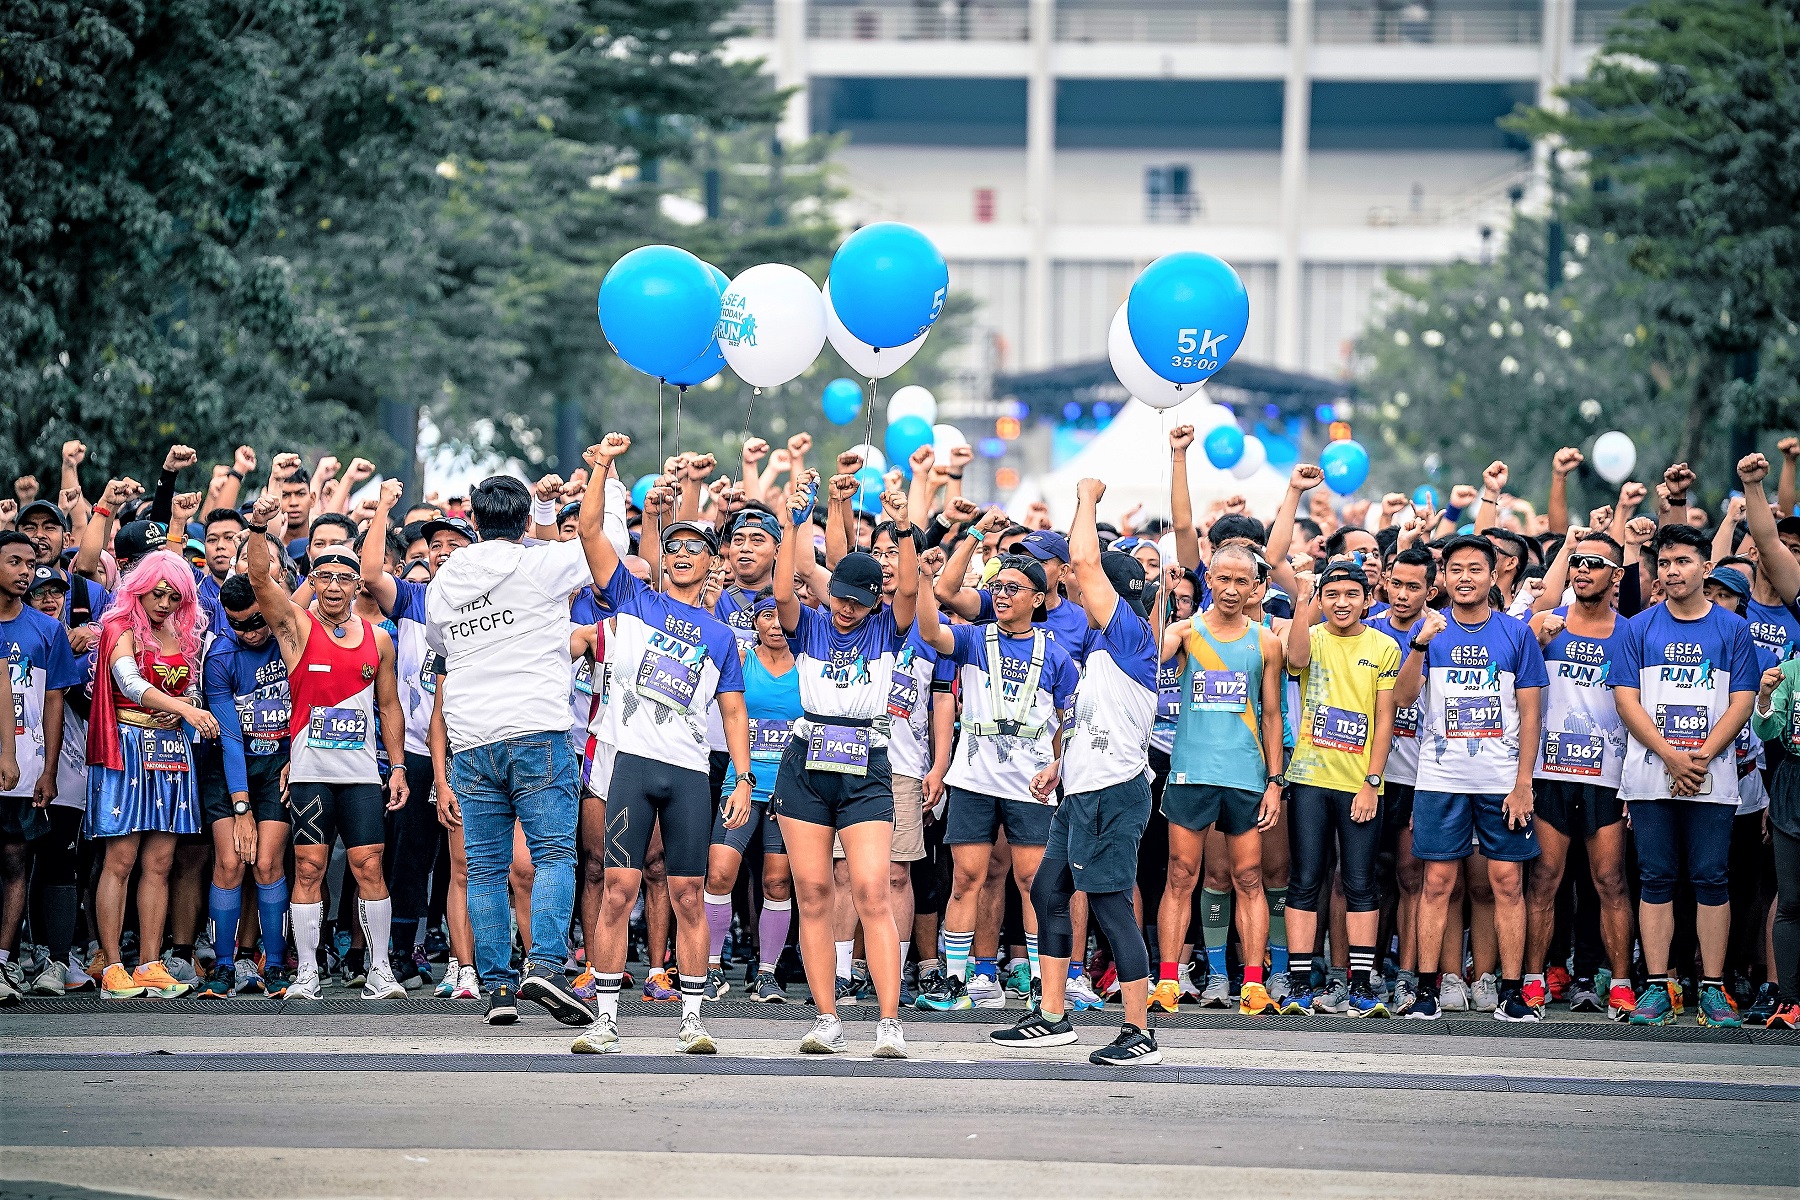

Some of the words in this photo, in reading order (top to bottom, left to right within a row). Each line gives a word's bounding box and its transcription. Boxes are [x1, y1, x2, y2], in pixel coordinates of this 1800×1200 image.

[726, 294, 746, 310] SEA
[722, 309, 744, 320] TODAY
[717, 320, 740, 341] RUN
[1178, 328, 1229, 357] 5K
[1171, 355, 1218, 371] 35:00
[449, 609, 514, 640] FCFCFC
[676, 619, 701, 638] SEA
[1761, 623, 1787, 637] SEA
[673, 626, 701, 644] TODAY
[1760, 632, 1787, 645] TODAY
[647, 631, 689, 659] RUN
[1463, 645, 1489, 658] SEA
[1577, 642, 1604, 657] SEA
[1676, 642, 1702, 655] SEA
[1004, 656, 1029, 673] SEA
[1462, 658, 1488, 666] TODAY
[1576, 653, 1603, 664] TODAY
[1675, 654, 1702, 663] TODAY
[265, 658, 286, 675] SEA
[1160, 667, 1179, 679] SE
[1558, 663, 1595, 682] RUN
[422, 672, 431, 682] M
[1002, 668, 1029, 680] TODAY
[1193, 671, 1206, 680] 5K
[1446, 669, 1482, 685] RUN
[1660, 667, 1695, 682] RUN
[655, 669, 694, 698] PACER
[1214, 681, 1247, 695] 1172
[889, 682, 917, 703] 748
[1194, 693, 1204, 702] M
[313, 706, 326, 716] 5K
[1470, 707, 1501, 721] 1417
[1656, 705, 1667, 714] 5K
[243, 723, 253, 732] M
[331, 718, 365, 733] 1682
[1336, 719, 1366, 737] 1132
[1448, 721, 1459, 731] M
[1673, 715, 1708, 730] 1689
[143, 729, 156, 738] 5K
[311, 729, 322, 739] M
[1547, 731, 1560, 741] 5K
[161, 739, 185, 754] 1086
[826, 740, 867, 757] PACER
[1565, 743, 1603, 759] 1367
[147, 752, 153, 762] F
[812, 750, 819, 761] F
[1547, 754, 1557, 764] M
[1545, 765, 1573, 774] NATIONAL
